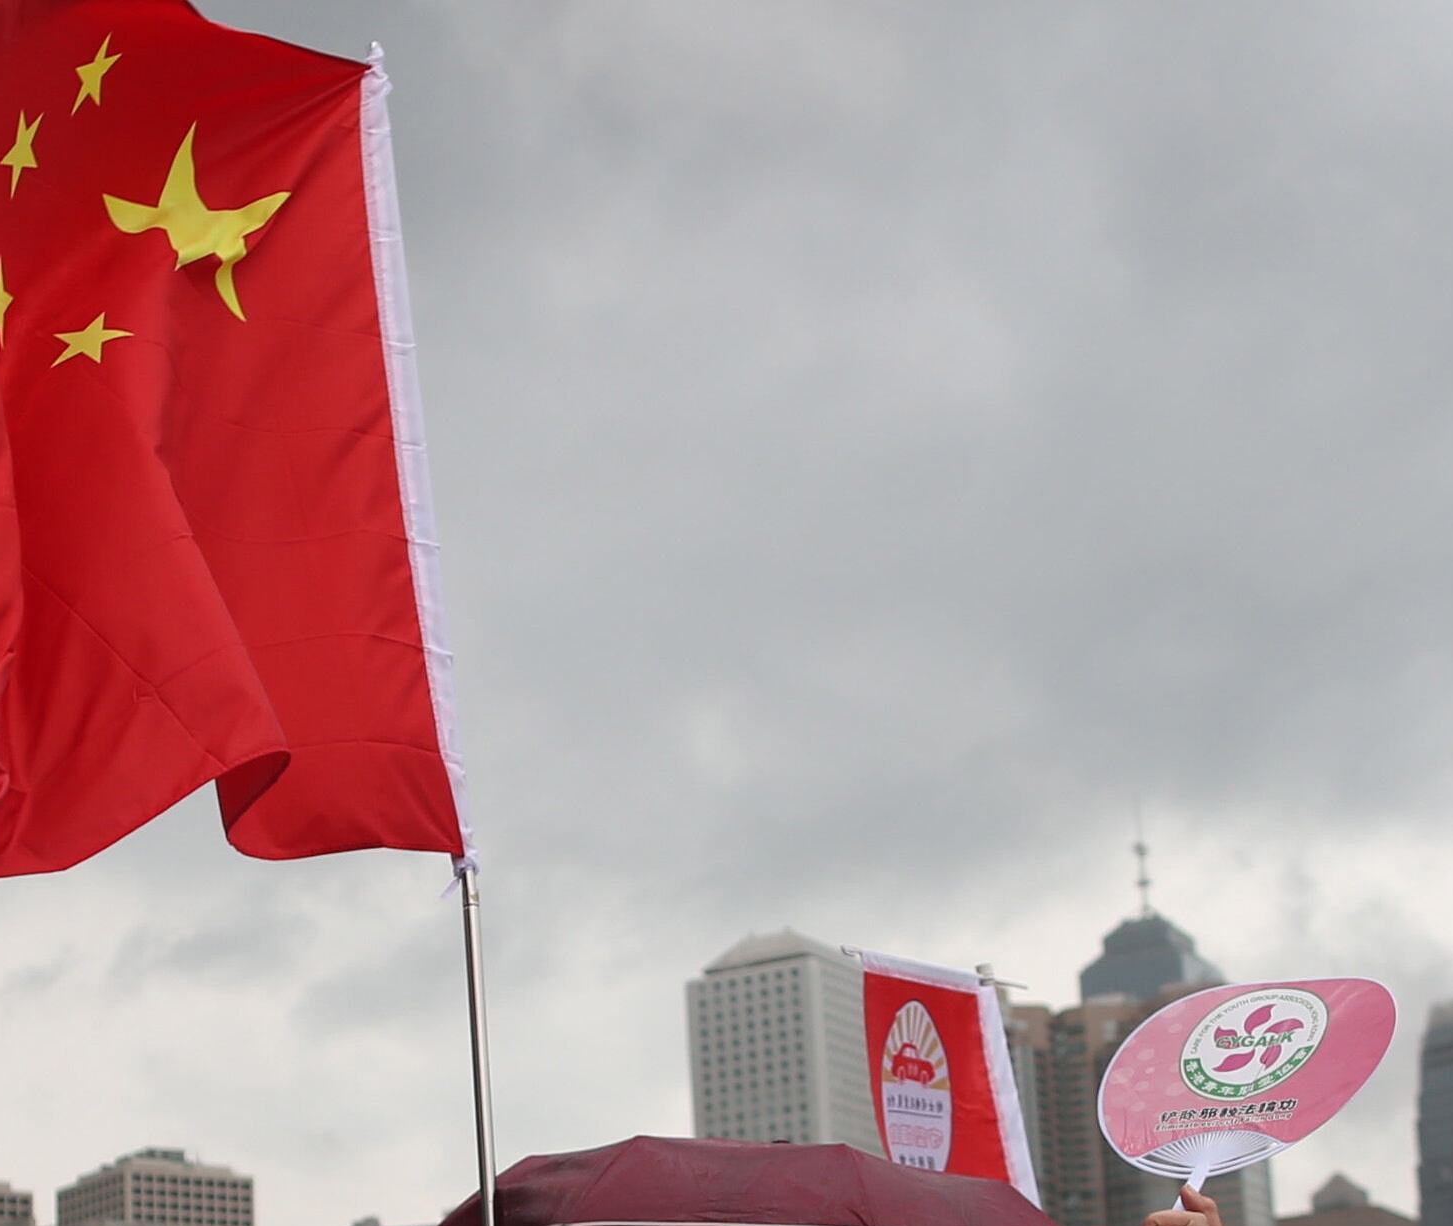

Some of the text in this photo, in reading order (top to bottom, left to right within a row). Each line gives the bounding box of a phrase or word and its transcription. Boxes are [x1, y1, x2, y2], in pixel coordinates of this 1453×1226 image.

[1209, 1013, 1224, 1026] THE
[1223, 1000, 1249, 1014] YOUTH
[1250, 995, 1278, 1004] GROUP
